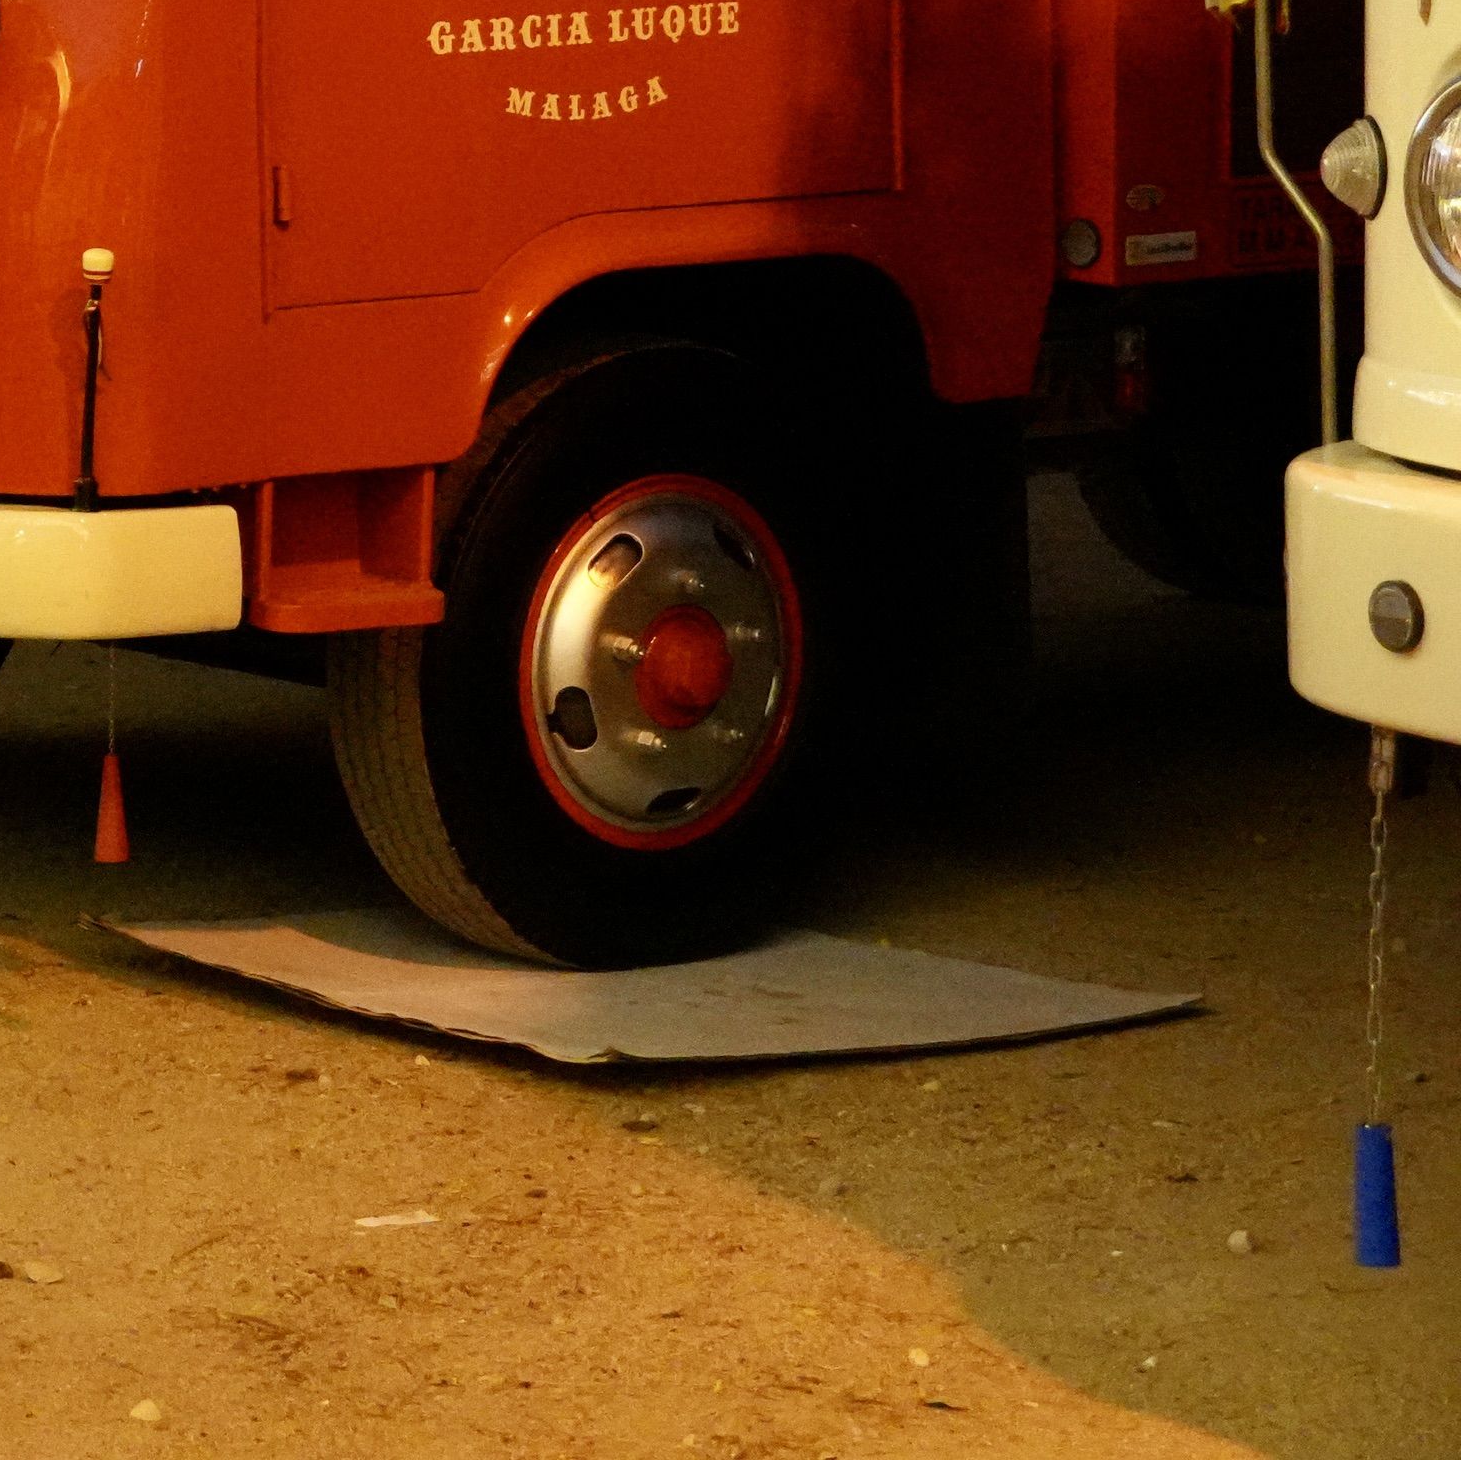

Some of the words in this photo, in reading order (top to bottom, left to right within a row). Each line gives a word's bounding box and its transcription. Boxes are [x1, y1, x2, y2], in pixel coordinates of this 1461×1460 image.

[427, 13, 593, 55] GARCIA
[608, 1, 739, 43] LUQUE
[505, 76, 669, 121] MALAGA
